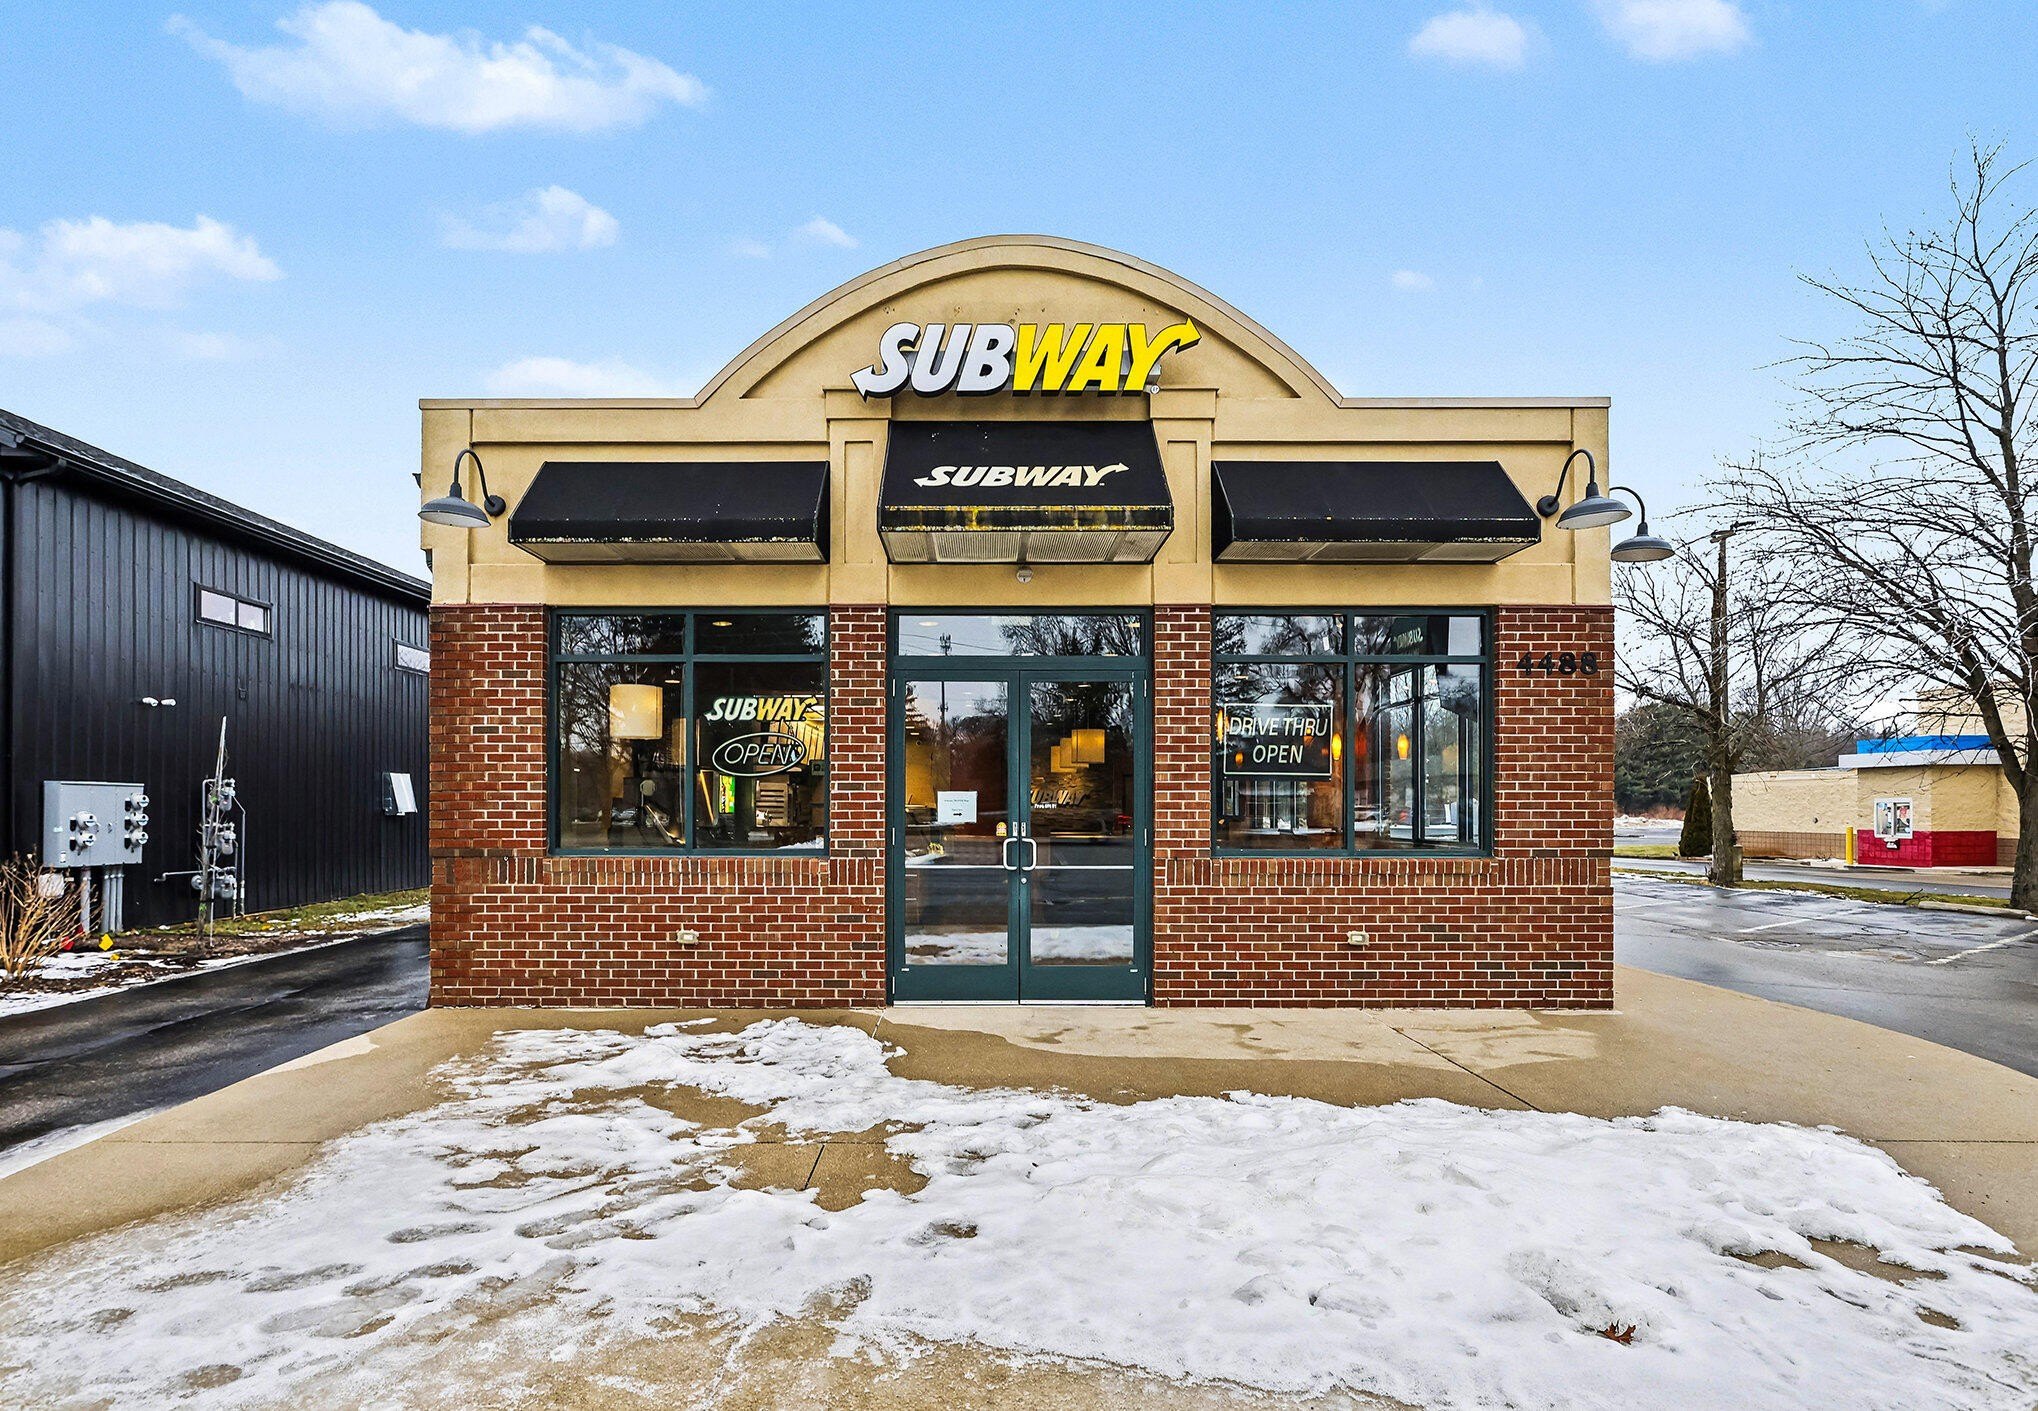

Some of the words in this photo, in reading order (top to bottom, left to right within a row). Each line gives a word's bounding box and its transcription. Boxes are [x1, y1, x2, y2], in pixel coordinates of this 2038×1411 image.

[850, 317, 1202, 402] SUBWAY
[913, 462, 1129, 487] SUBWAY
[1516, 652, 1598, 675] 4488
[704, 697, 818, 721] SUBWAY
[1229, 717, 1279, 736] DRIVE
[1283, 718, 1328, 736] THRU
[725, 743, 792, 765] OPEN
[1253, 745, 1303, 763] OPEN
